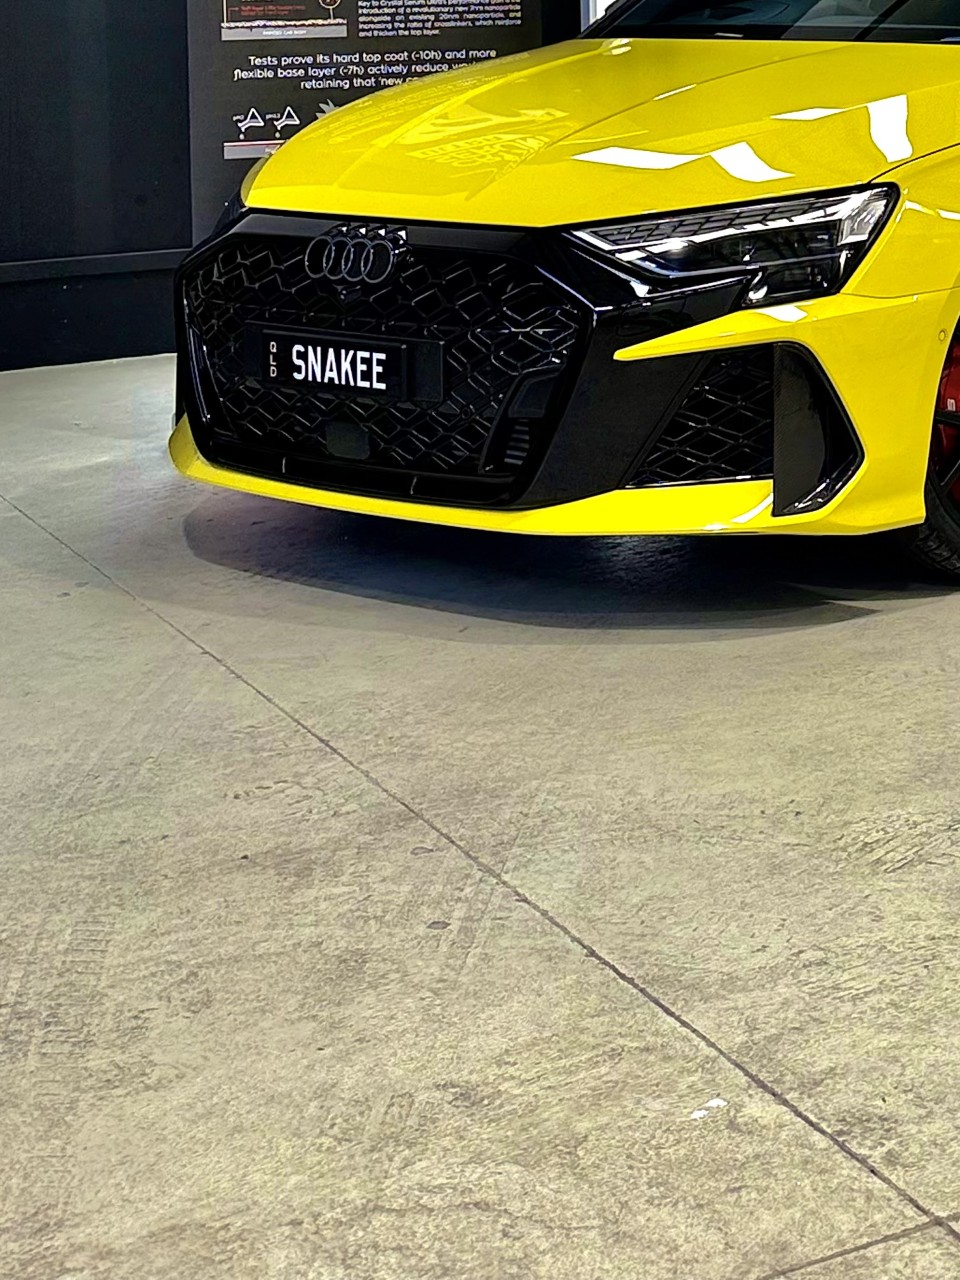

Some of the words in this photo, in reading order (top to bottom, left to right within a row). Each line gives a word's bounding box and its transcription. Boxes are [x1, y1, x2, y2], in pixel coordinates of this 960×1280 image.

[248, 56, 278, 65] Tests
[281, 55, 313, 66] prove
[317, 53, 330, 63] its
[333, 53, 359, 63] hard
[363, 52, 381, 62] top
[384, 51, 408, 61] coat
[445, 49, 465, 59] and
[469, 49, 497, 58] more
[234, 68, 274, 80] flexible
[277, 67, 305, 77] base
[308, 66, 336, 77] layer
[368, 63, 408, 75] actively
[412, 62, 449, 72] reduce
[301, 79, 350, 89] retaining
[353, 77, 376, 87] that
[269, 341, 277, 377] QLD
[292, 344, 387, 390] SNAKEE
